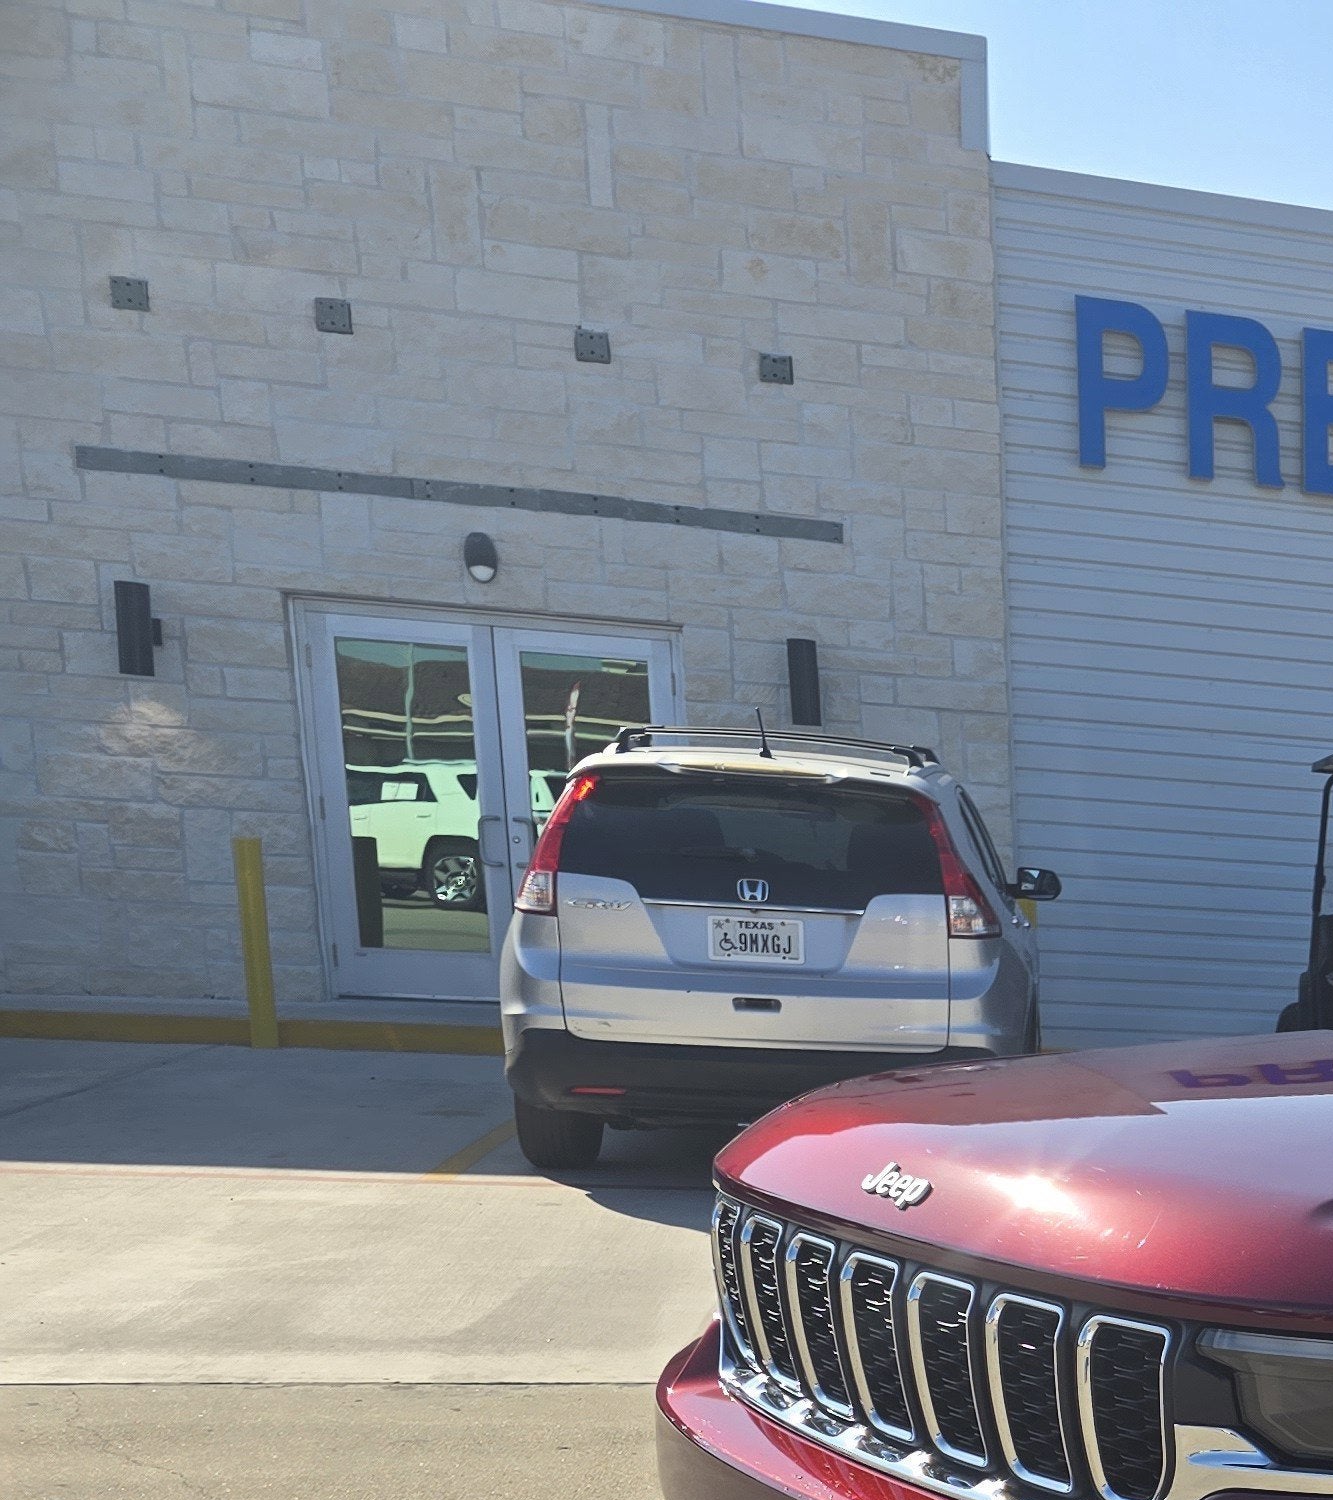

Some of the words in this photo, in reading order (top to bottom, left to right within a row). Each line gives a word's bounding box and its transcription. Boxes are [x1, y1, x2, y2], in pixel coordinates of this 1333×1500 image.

[738, 920, 775, 931] TEXAS
[738, 932, 792, 955] 9MXGJ
[860, 1161, 932, 1209] Jeep
